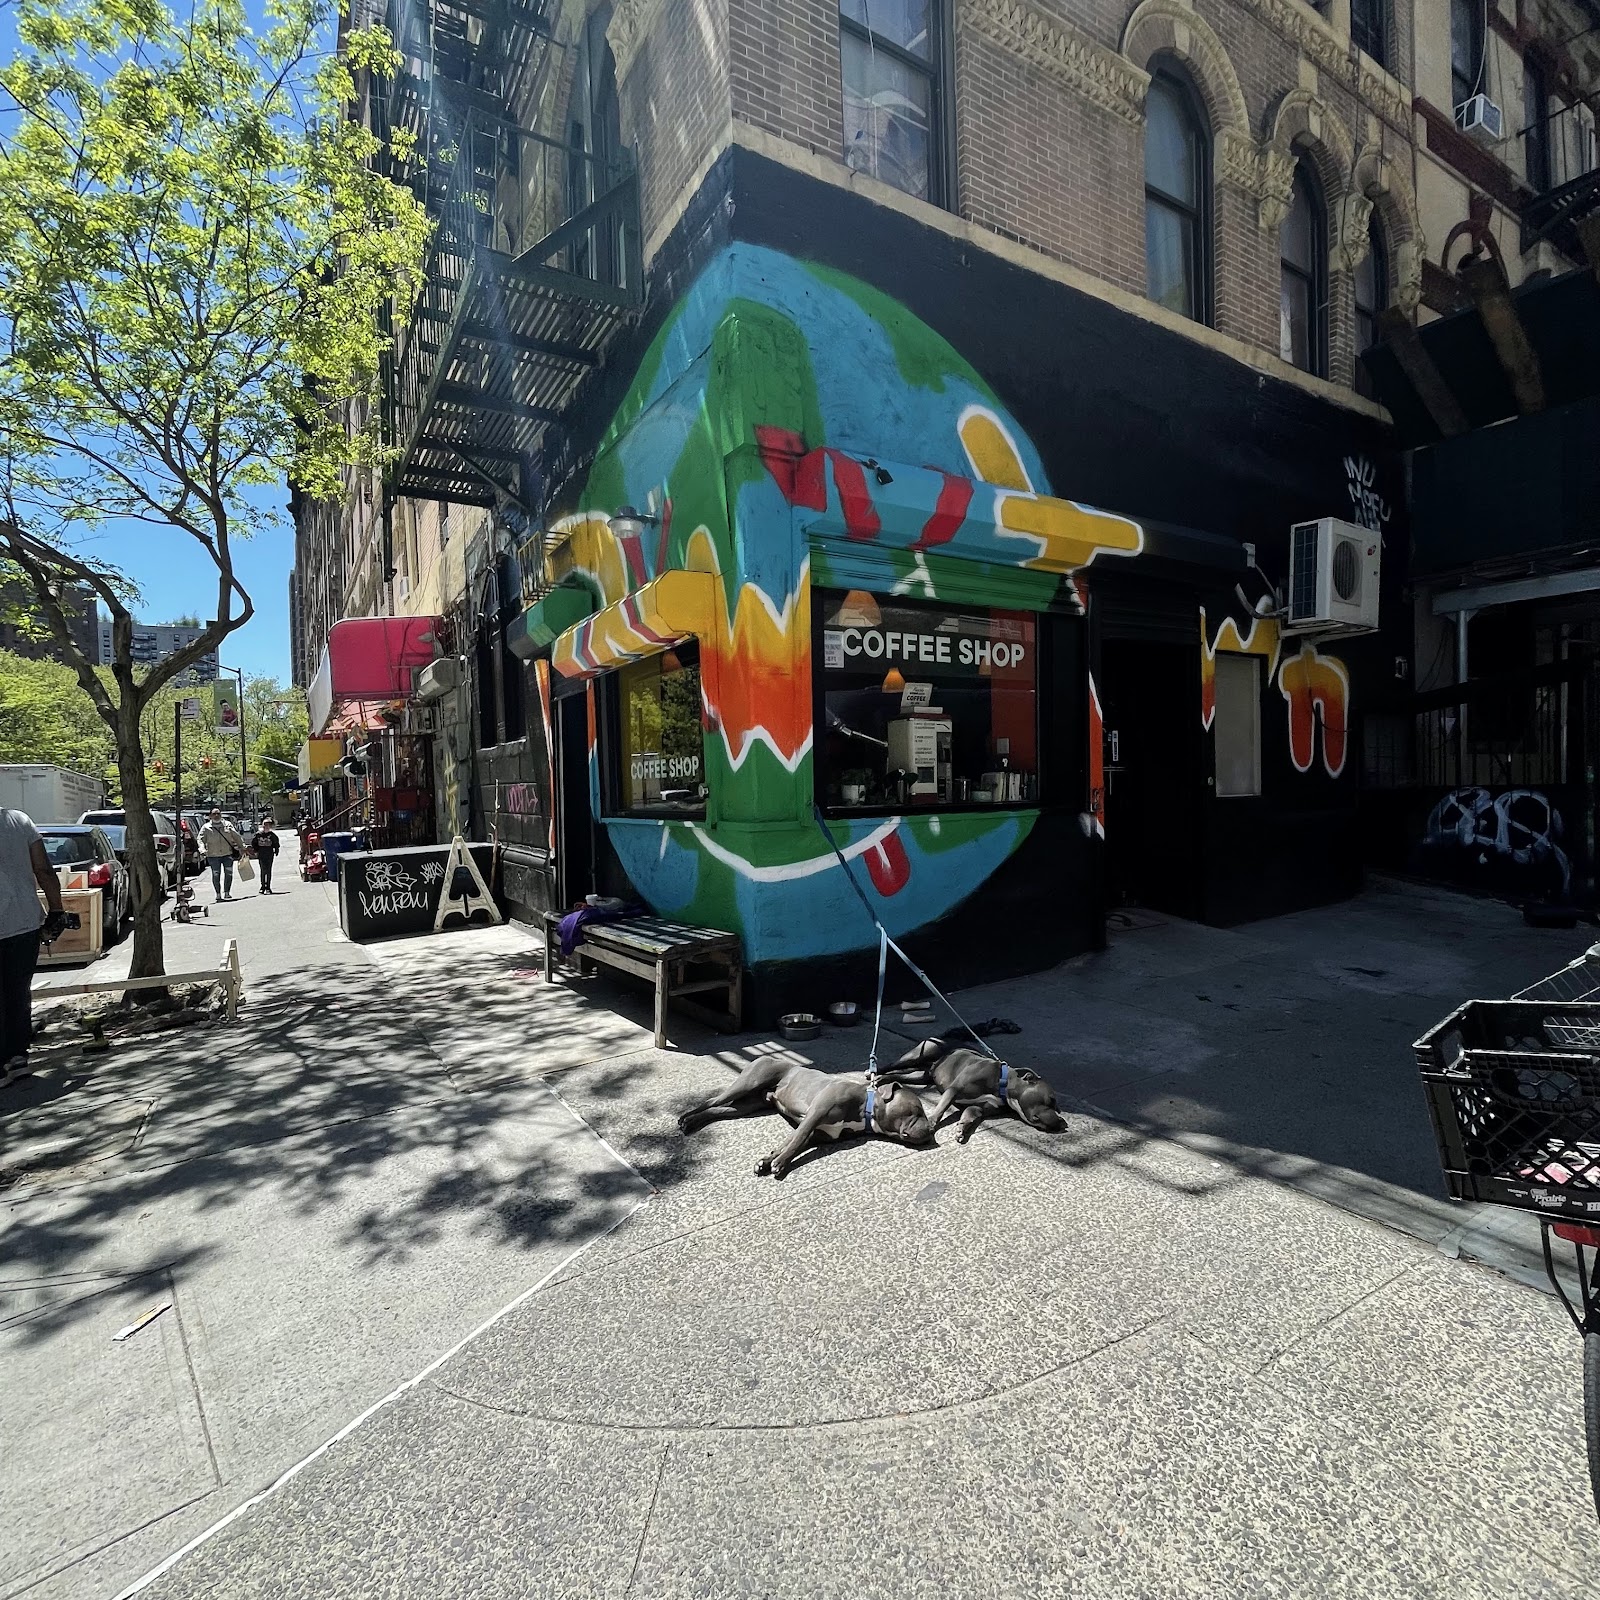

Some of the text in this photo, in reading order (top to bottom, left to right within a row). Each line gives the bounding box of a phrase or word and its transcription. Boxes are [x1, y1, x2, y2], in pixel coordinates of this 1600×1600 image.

[843, 628, 951, 663] COFFEE
[958, 638, 1025, 668] SHOP
[631, 756, 699, 780] COFFEE SHOP
[1534, 1194, 1567, 1202] Prairie
